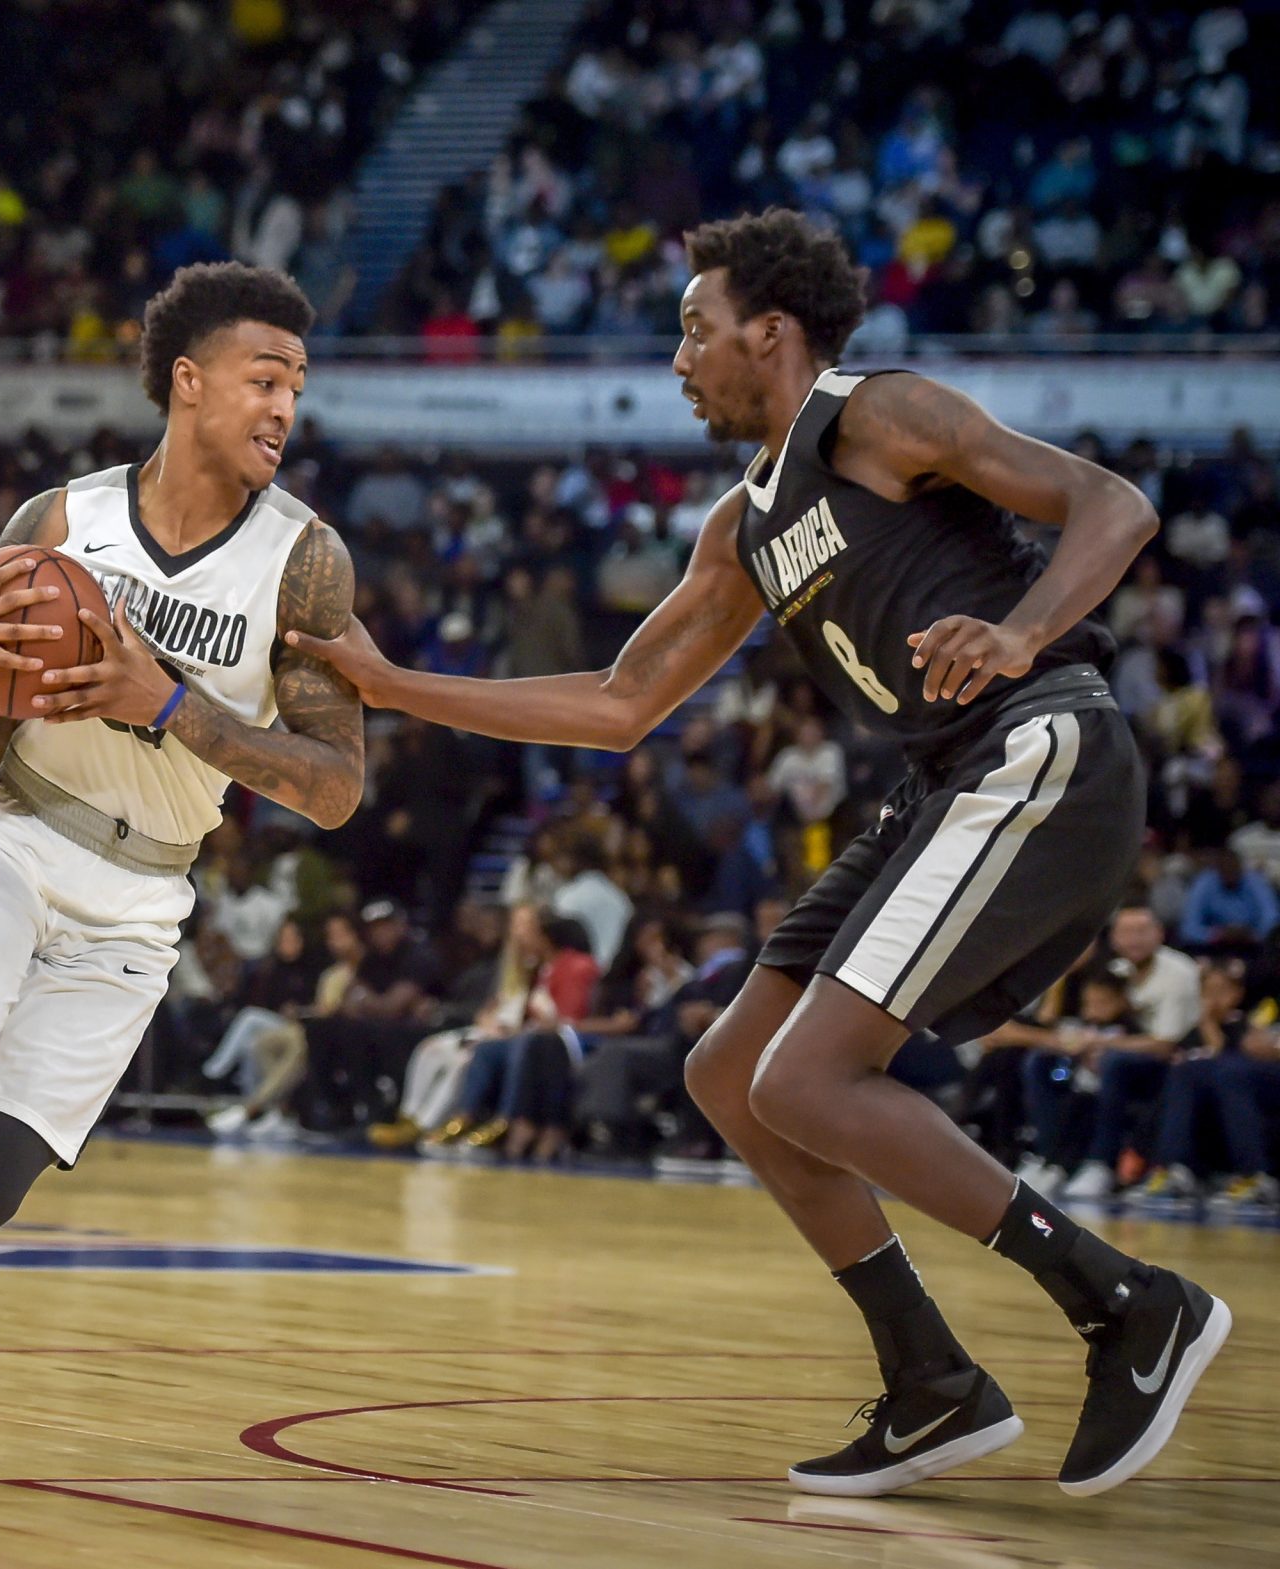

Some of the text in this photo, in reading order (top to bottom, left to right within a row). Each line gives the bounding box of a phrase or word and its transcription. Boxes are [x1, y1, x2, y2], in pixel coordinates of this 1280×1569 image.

[770, 496, 849, 598] AFRICA
[144, 589, 248, 668] WORLD
[822, 619, 899, 715] 8
